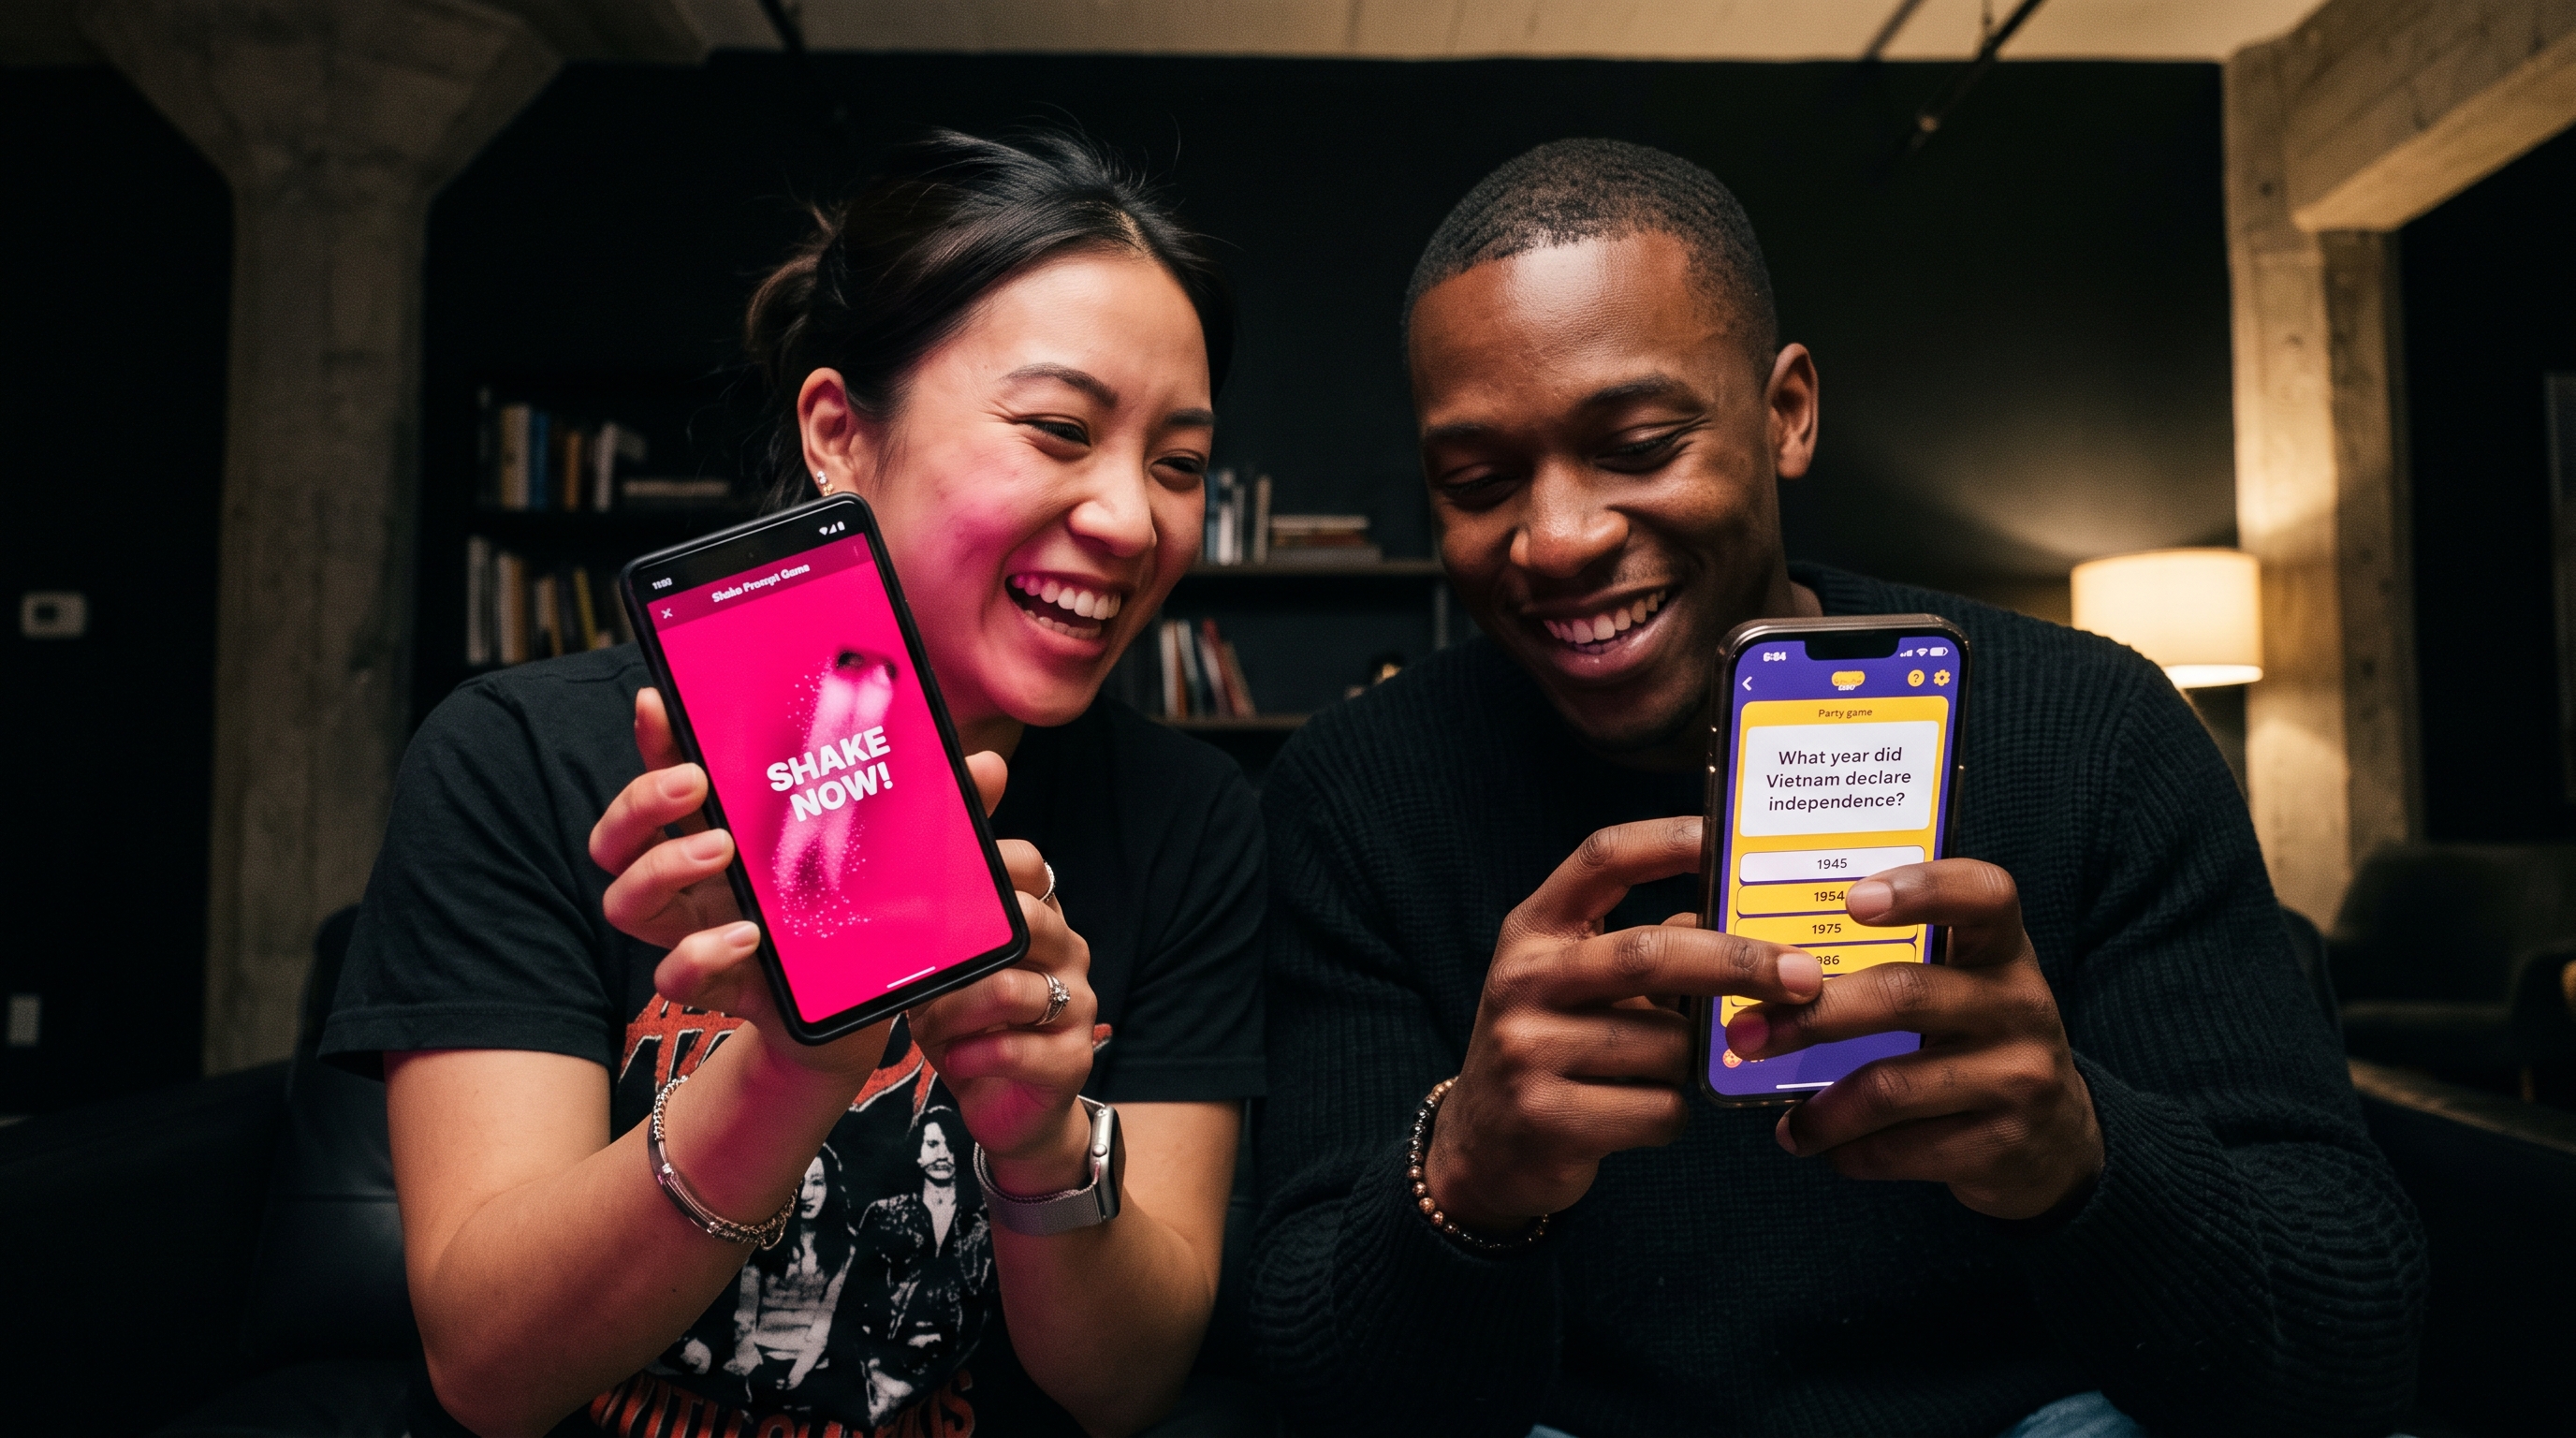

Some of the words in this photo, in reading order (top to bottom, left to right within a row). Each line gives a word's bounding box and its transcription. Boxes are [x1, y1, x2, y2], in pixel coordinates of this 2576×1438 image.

[1818, 710, 1844, 719] Party
[1846, 709, 1873, 719] game
[767, 726, 891, 792] SHAKE
[1778, 751, 1826, 765] What
[1830, 751, 1870, 767] year
[1874, 747, 1902, 761] did
[1766, 773, 1840, 788] Vietnam
[1845, 770, 1911, 785] declare
[789, 761, 893, 822] NOW!
[1769, 792, 1905, 813] independence?
[1817, 858, 1848, 870] 1945
[1814, 890, 1845, 902] 1954
[1811, 923, 1841, 934] 1975
[1815, 955, 1840, 965] 986
